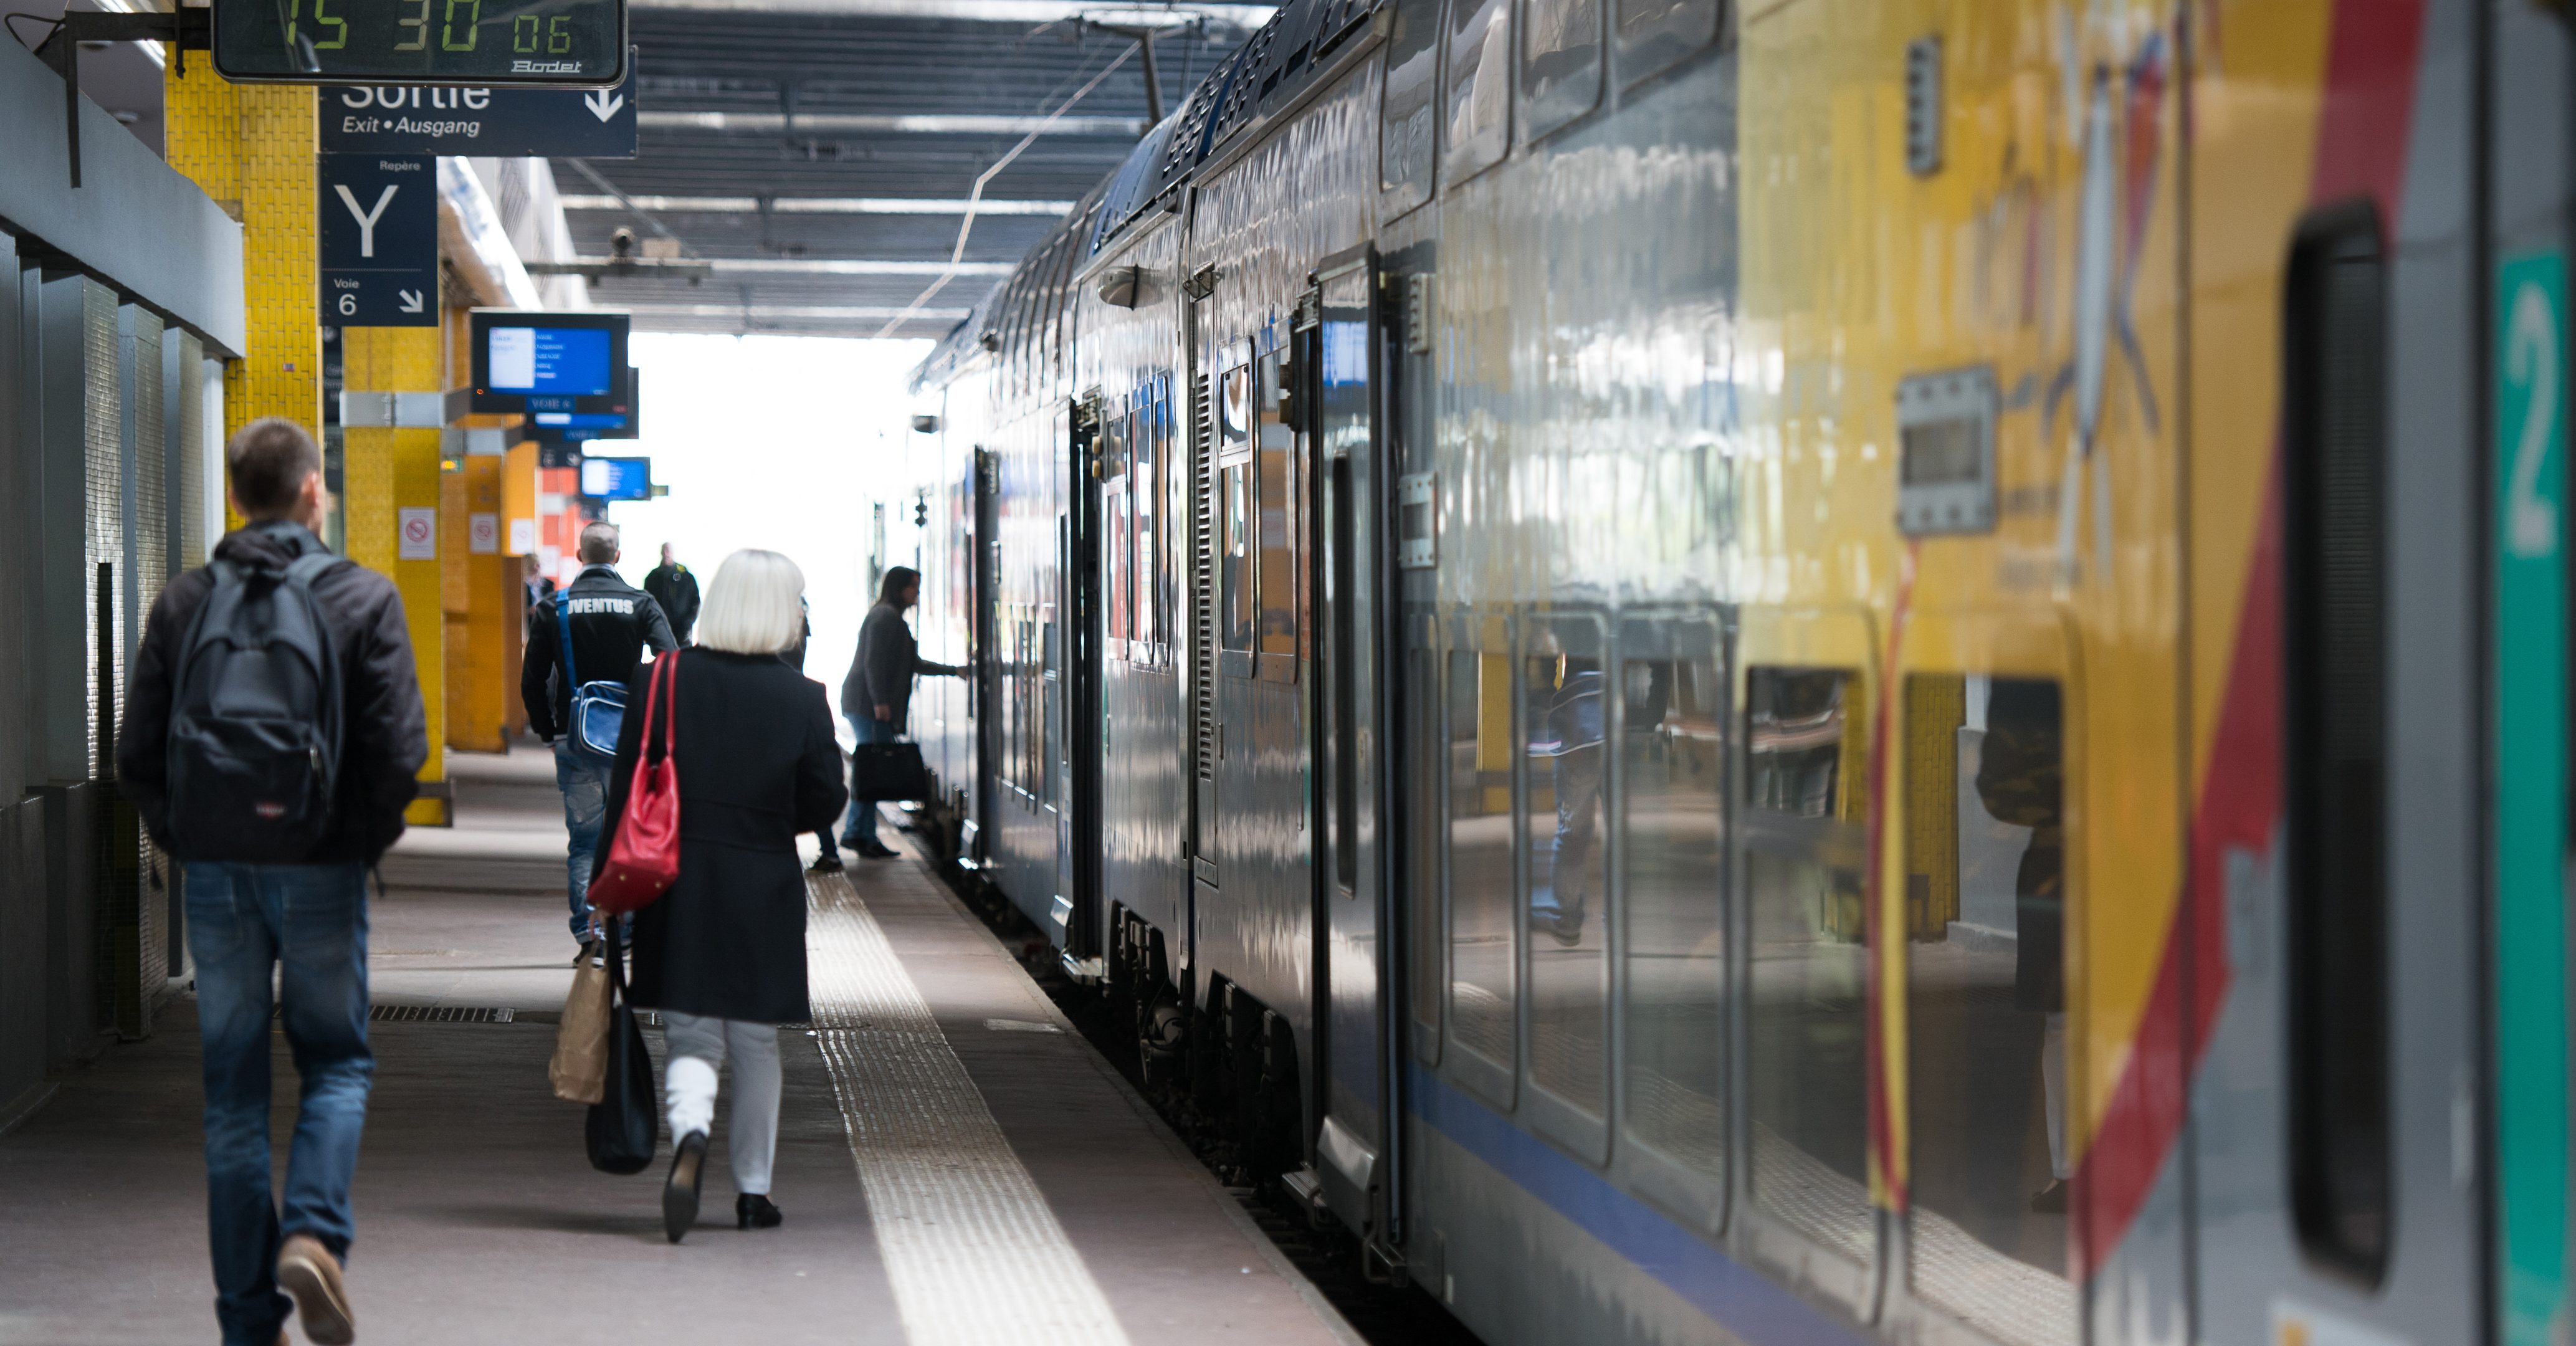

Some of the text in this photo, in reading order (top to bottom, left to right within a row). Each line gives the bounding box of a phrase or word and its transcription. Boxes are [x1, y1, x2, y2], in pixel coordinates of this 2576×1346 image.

[287, 0, 571, 54] 15 30 06
[511, 60, 582, 73] Bodet
[342, 115, 480, 138] Exit Ausgang
[379, 160, 421, 172] Repère
[333, 184, 399, 257] Y
[334, 279, 360, 289] Voie
[338, 294, 356, 316] 6
[2505, 278, 2560, 557] 2
[556, 598, 634, 616] UVENTUS
